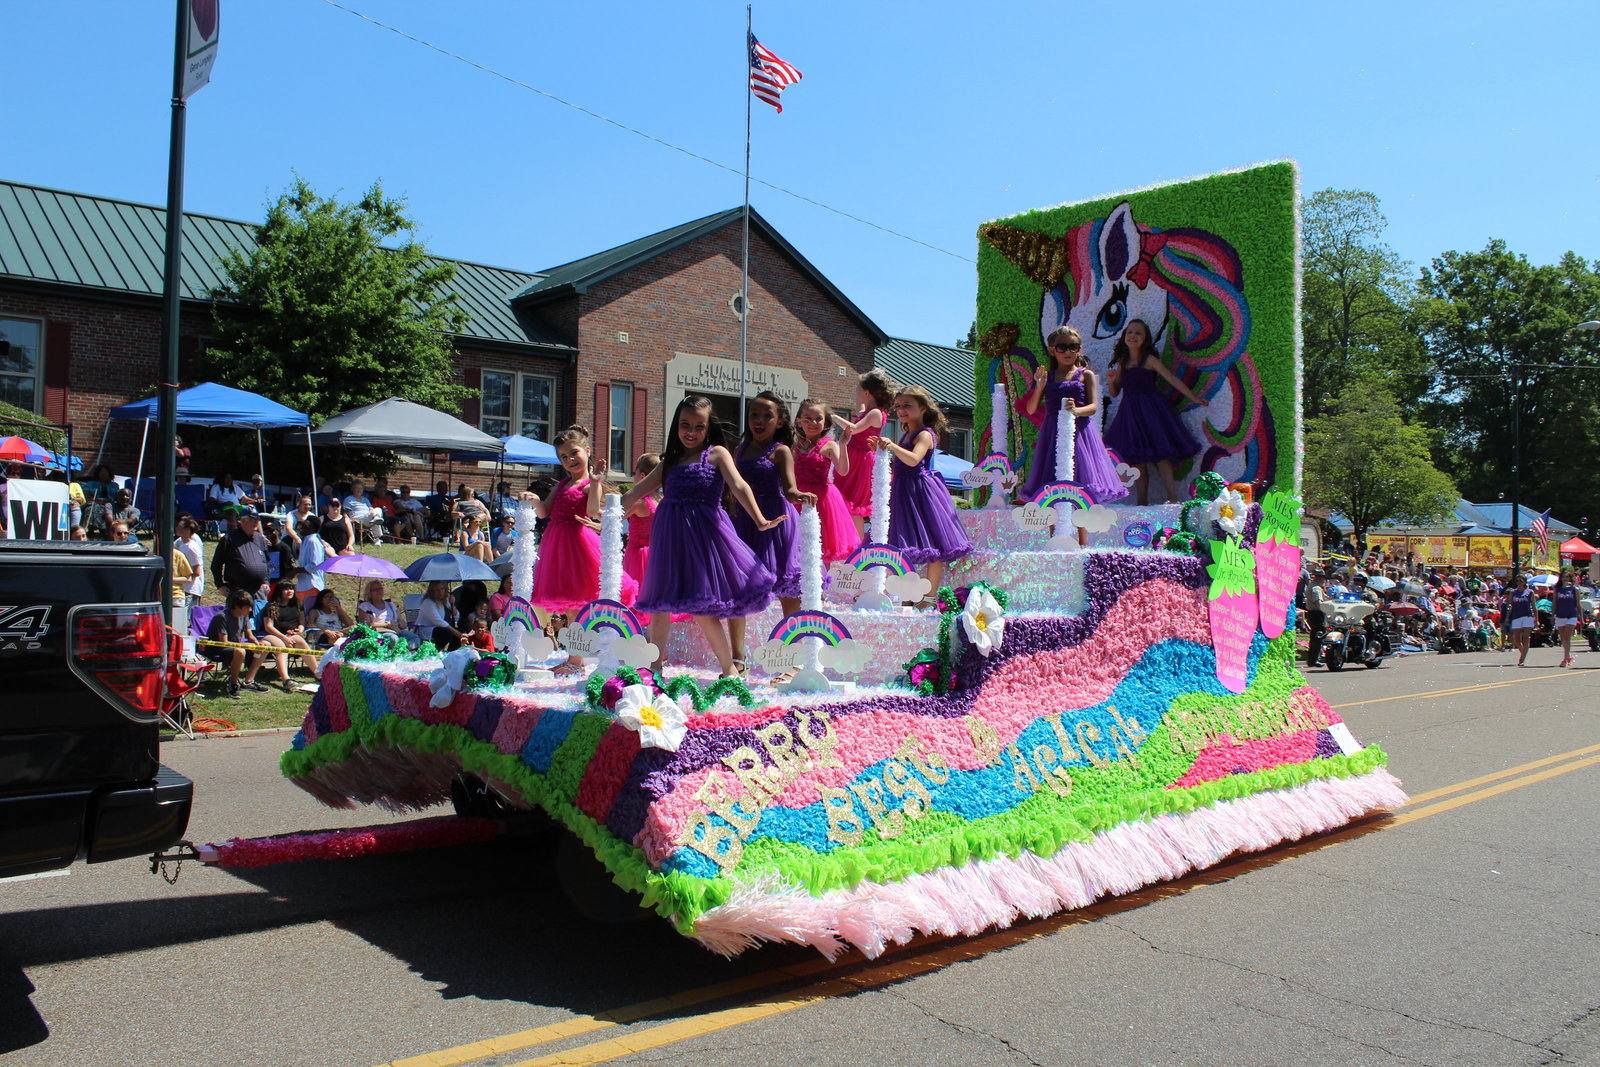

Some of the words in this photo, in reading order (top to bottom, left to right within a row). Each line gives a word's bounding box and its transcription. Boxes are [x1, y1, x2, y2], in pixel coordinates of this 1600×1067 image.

[677, 373, 745, 394] ELEMENTAR
[964, 472, 988, 485] Queen
[1044, 485, 1084, 500] SOPHIE
[1021, 507, 1036, 517] 1st
[1272, 497, 1295, 520] MES
[1025, 514, 1051, 526] maid
[1266, 511, 1295, 538] Royalty
[860, 547, 902, 566] MEREDITH
[1224, 549, 1246, 569] MES
[836, 569, 853, 581] 2nd
[1228, 570, 1249, 587] Royalty
[837, 578, 864, 590] maid
[590, 603, 627, 626] KATIE
[786, 616, 833, 634] OLIVIA
[566, 629, 583, 642] 4th
[569, 639, 592, 653] maid
[759, 644, 783, 659] 3rd
[767, 652, 797, 667] maid
[674, 705, 843, 873] BERRY
[816, 732, 949, 846] BEST
[965, 705, 1148, 797] MAGICAL
